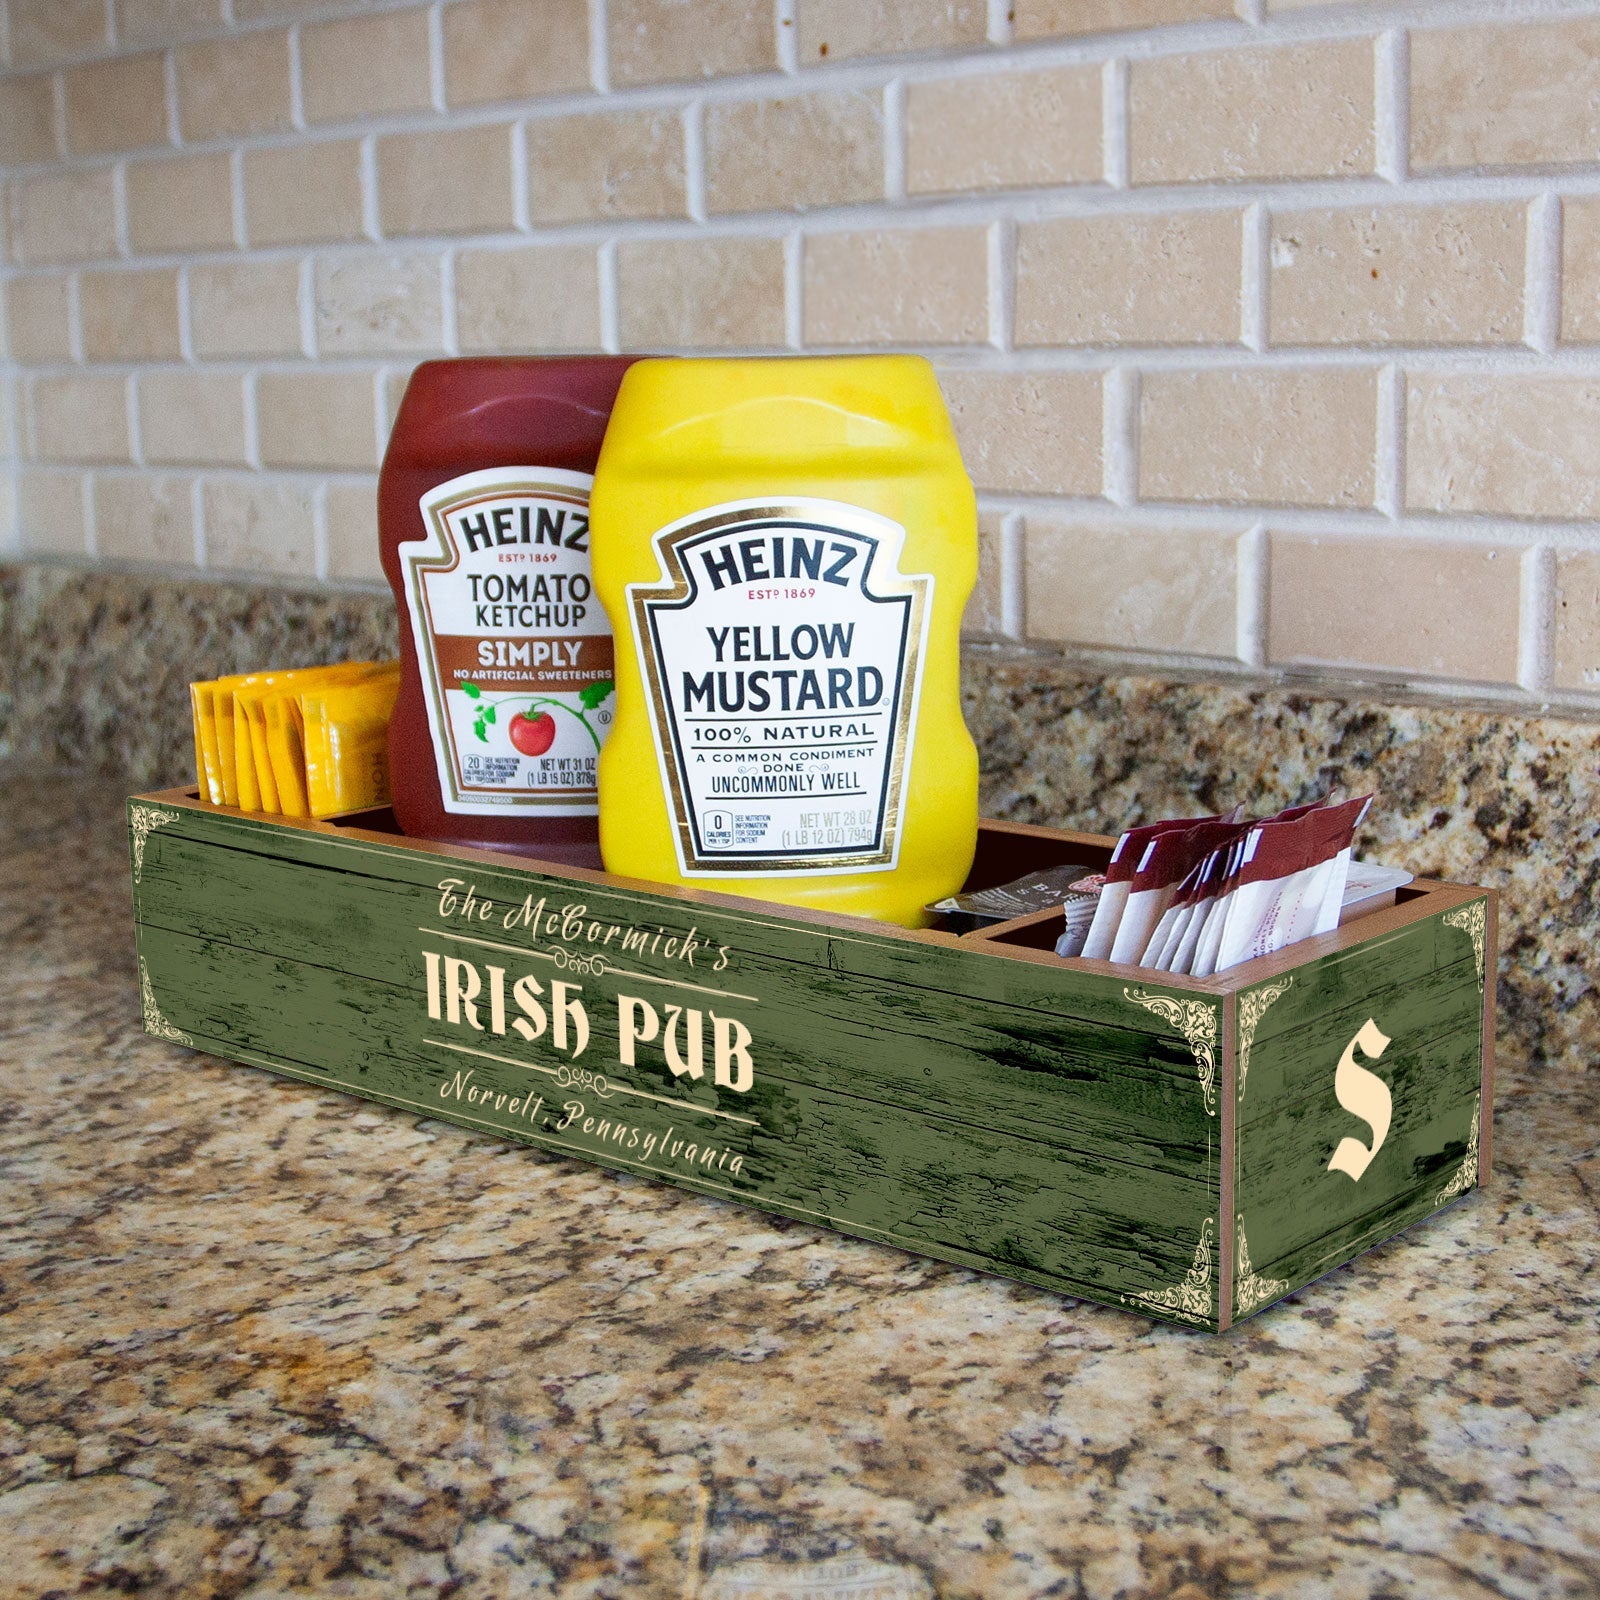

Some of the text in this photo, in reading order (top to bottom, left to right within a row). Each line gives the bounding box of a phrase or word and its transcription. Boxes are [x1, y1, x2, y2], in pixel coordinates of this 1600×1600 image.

[459, 506, 589, 553] HEINZ
[529, 552, 557, 563] 1869
[700, 537, 858, 591] HEINZ
[466, 573, 591, 602] TOMATO
[785, 588, 815, 599] 1869
[476, 605, 586, 627] KETCHUP
[706, 622, 855, 662] YELLOW
[478, 641, 583, 667] SIMPLY
[453, 670, 612, 681] NO ARTIFICIAL SWEETENERS
[683, 666, 884, 713] MUSTARD
[694, 723, 875, 743] 100% NATURAL
[468, 757, 480, 769] 20
[540, 758, 595, 771] NET WT 31 OZ
[696, 748, 874, 763] A COMMON CONDIMENT
[527, 771, 534, 786] (1
[537, 772, 547, 785] LB
[550, 772, 558, 785] 15
[560, 771, 574, 786] OZ)
[763, 764, 804, 773] DONE
[712, 771, 860, 793] UNCOMMONLY WELL
[714, 815, 722, 829] 0
[800, 812, 820, 828] NET
[823, 811, 840, 827] WT
[860, 809, 872, 825] OZ
[782, 827, 873, 849] (1 LB 12 OZ) 794g
[437, 878, 730, 971] The McCormick's
[422, 950, 754, 1093] IRISH PUB
[1328, 1017, 1392, 1182] S
[440, 1070, 744, 1176] Norvelt, Pennsylvania
